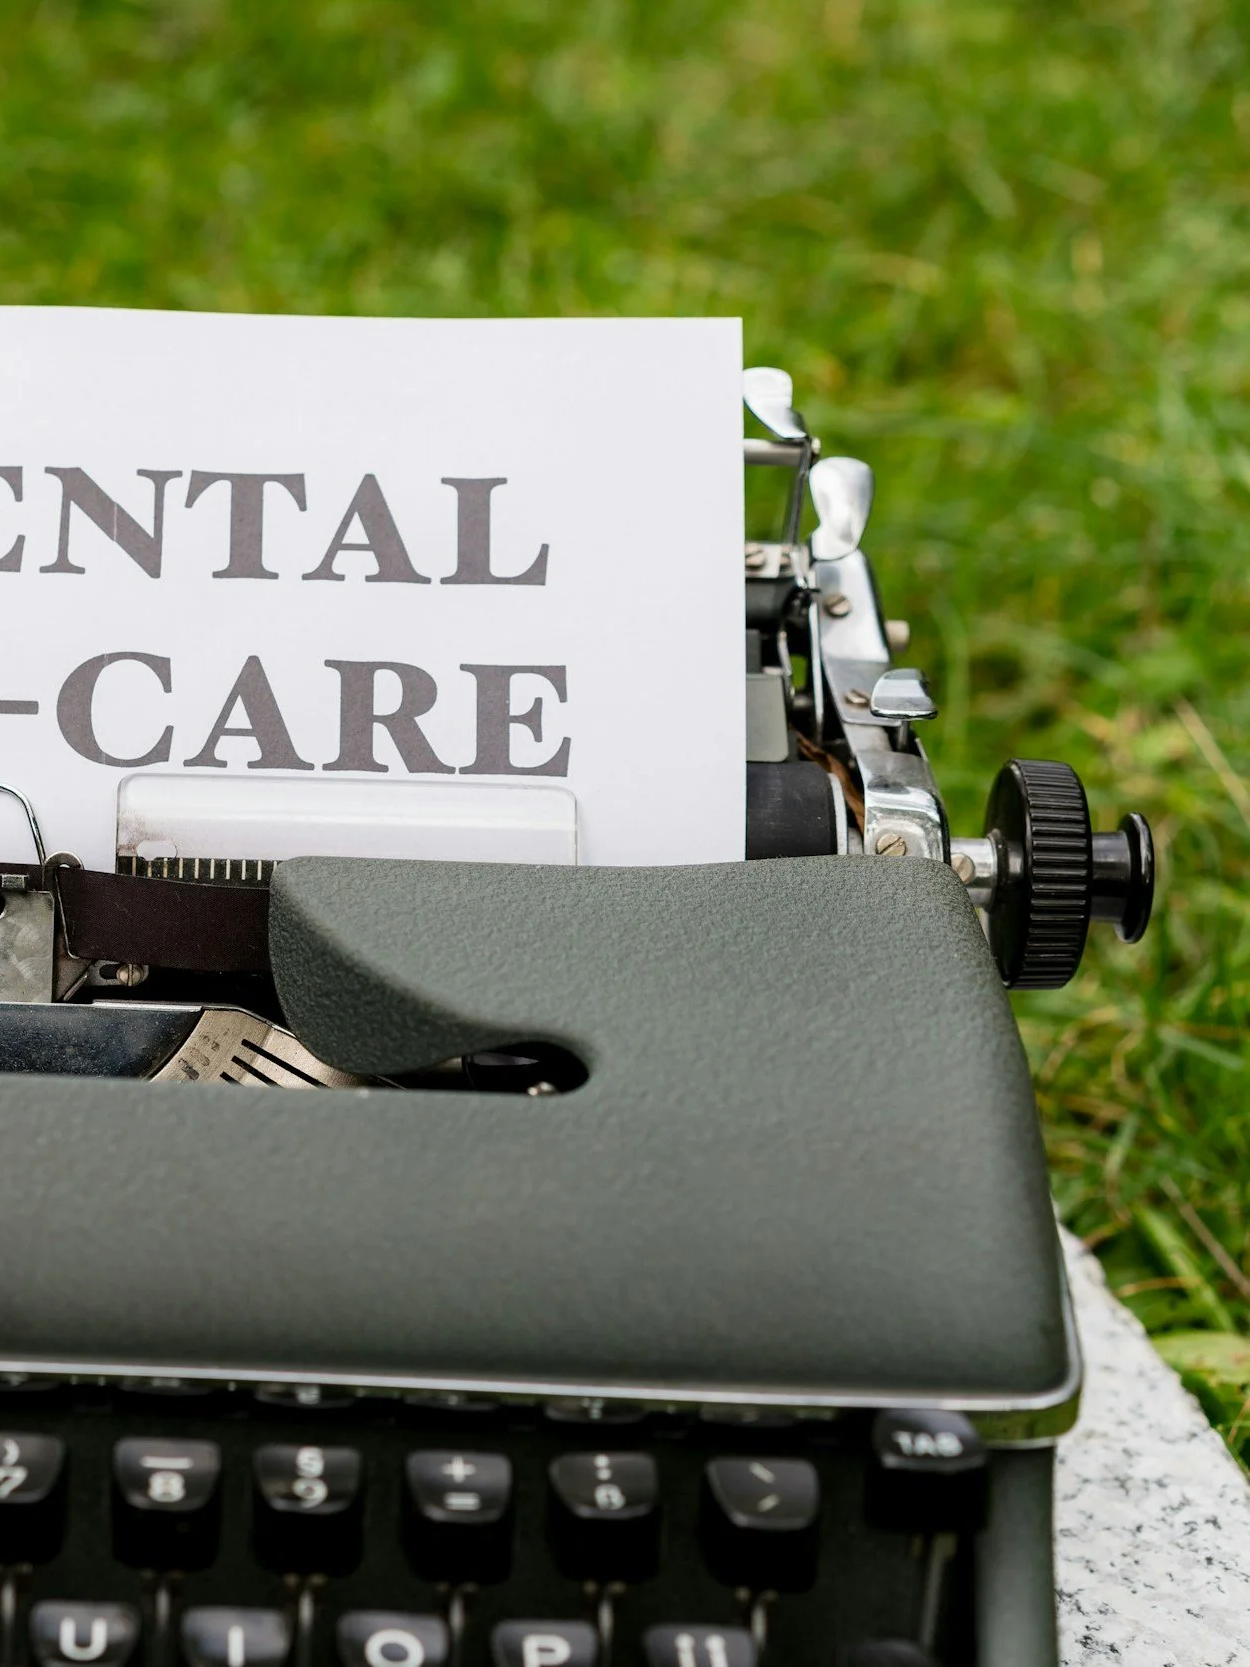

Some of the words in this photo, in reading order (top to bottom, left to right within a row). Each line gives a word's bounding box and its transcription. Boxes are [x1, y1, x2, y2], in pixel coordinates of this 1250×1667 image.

[893, 1430, 962, 1457] TAB
[148, 1471, 187, 1503] 8
[292, 1476, 329, 1510] 9
[59, 1618, 108, 1661] U
[365, 1629, 424, 1667] O
[523, 1635, 571, 1667] P
